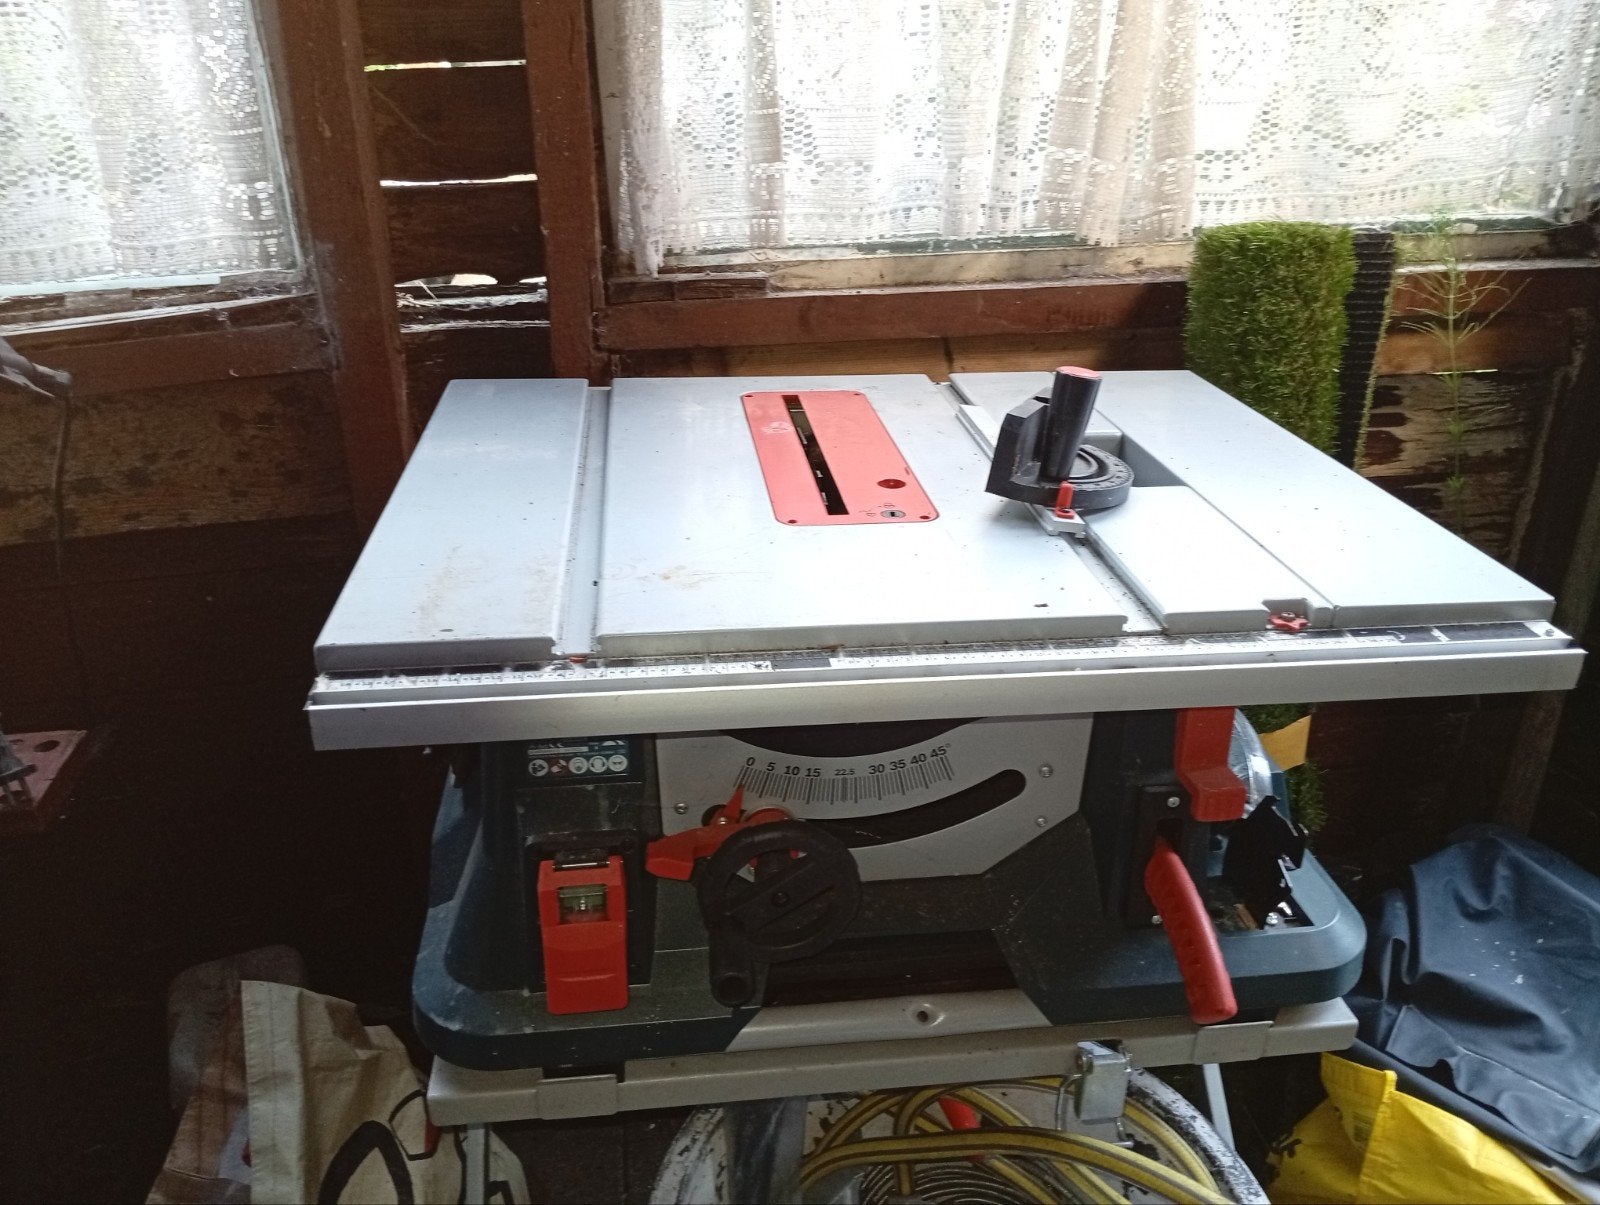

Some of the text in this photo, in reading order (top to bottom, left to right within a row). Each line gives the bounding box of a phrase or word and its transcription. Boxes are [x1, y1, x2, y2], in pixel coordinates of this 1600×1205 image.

[746, 757, 756, 767] 0
[766, 762, 776, 772] 5
[783, 765, 800, 776] 10
[805, 768, 821, 778] 15
[834, 768, 856, 776] 22.5
[868, 764, 885, 775] 30
[889, 759, 907, 771] 35
[910, 753, 927, 765] 40
